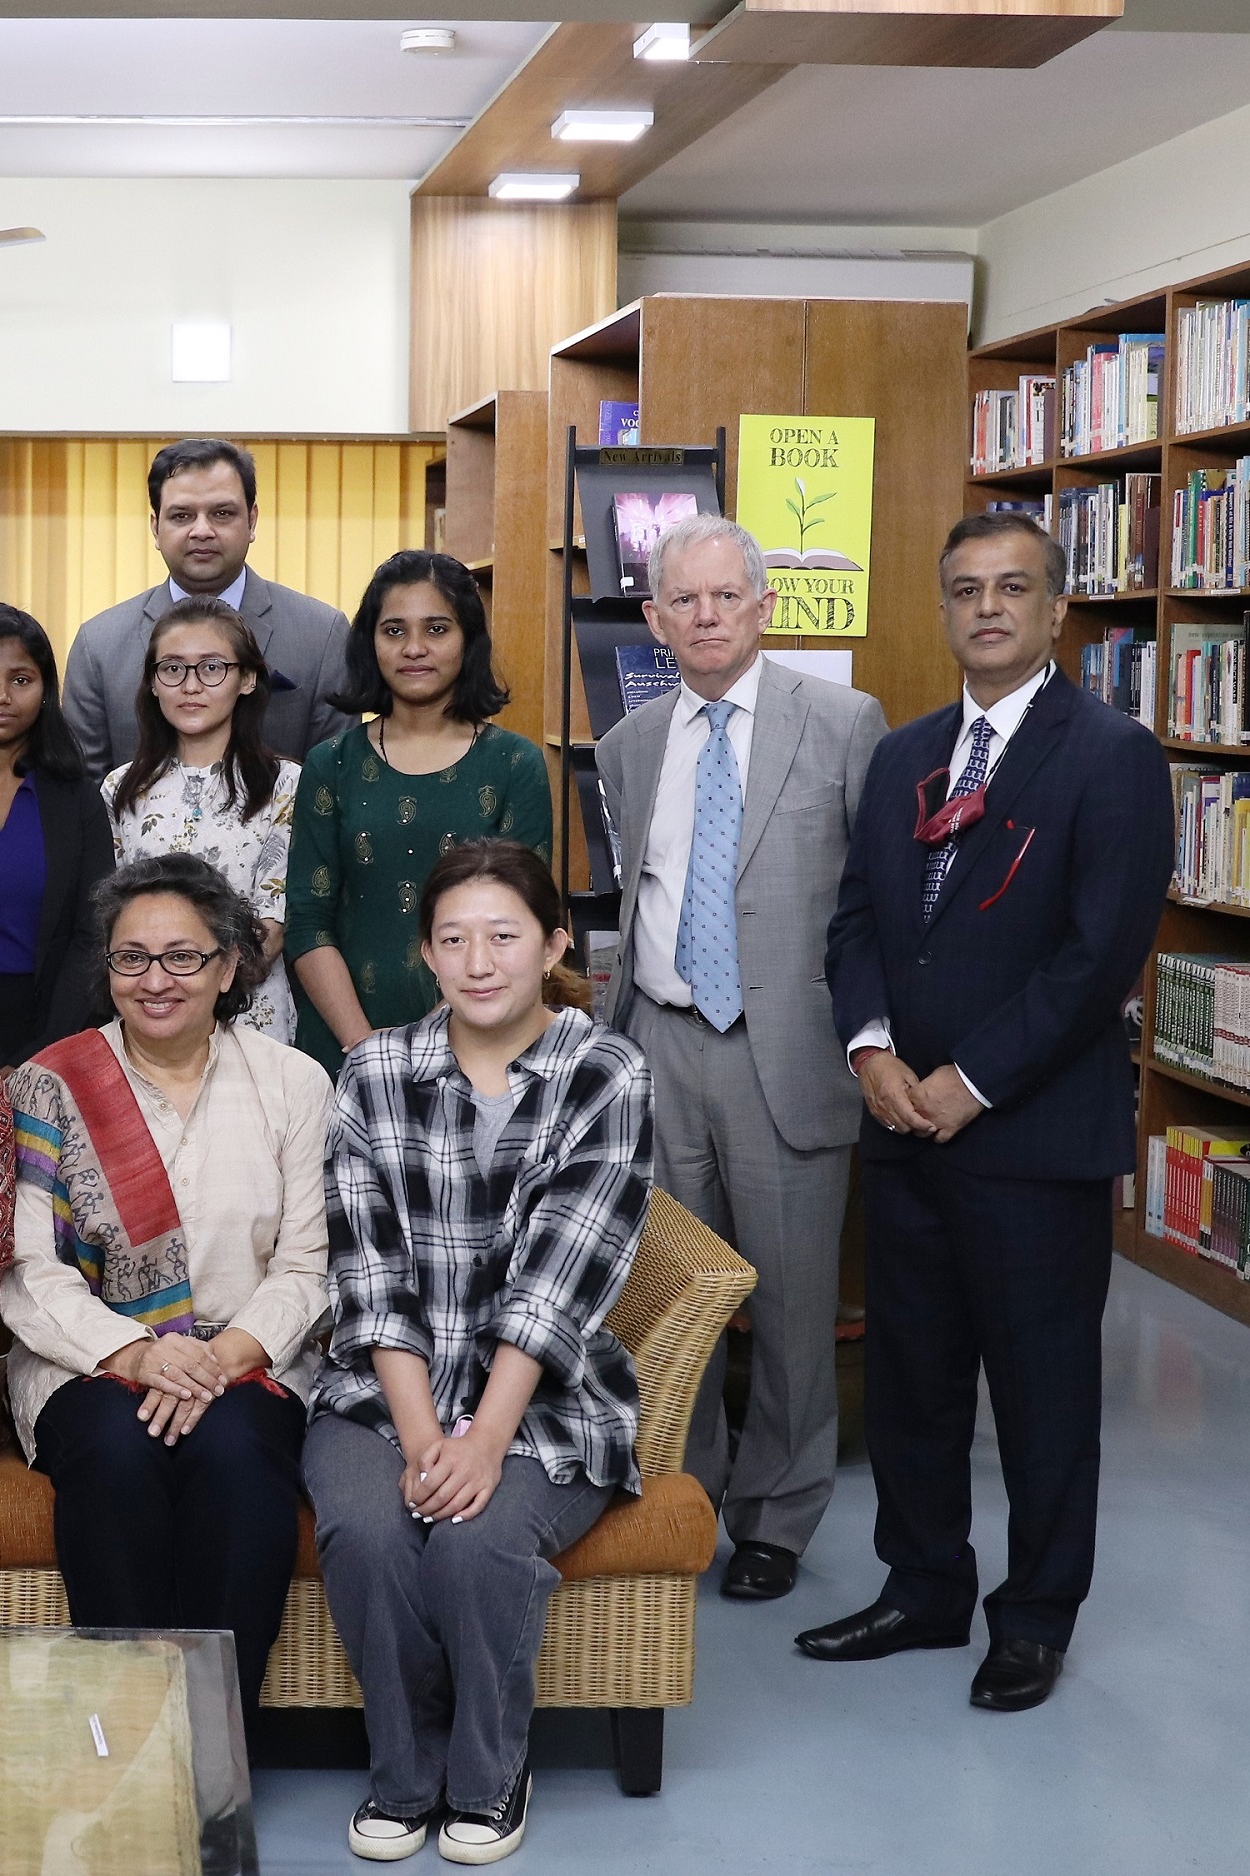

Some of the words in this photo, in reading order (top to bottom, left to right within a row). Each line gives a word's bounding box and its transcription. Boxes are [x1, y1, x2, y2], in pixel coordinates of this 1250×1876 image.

[770, 428, 822, 444] OPEN
[828, 430, 839, 444] A
[604, 450, 626, 462] New
[634, 450, 682, 462] Arrivals
[769, 447, 839, 467] BOOK
[804, 578, 854, 594] YOUR
[768, 596, 855, 630] IND
[655, 657, 677, 669] LE
[624, 672, 680, 680] Survival
